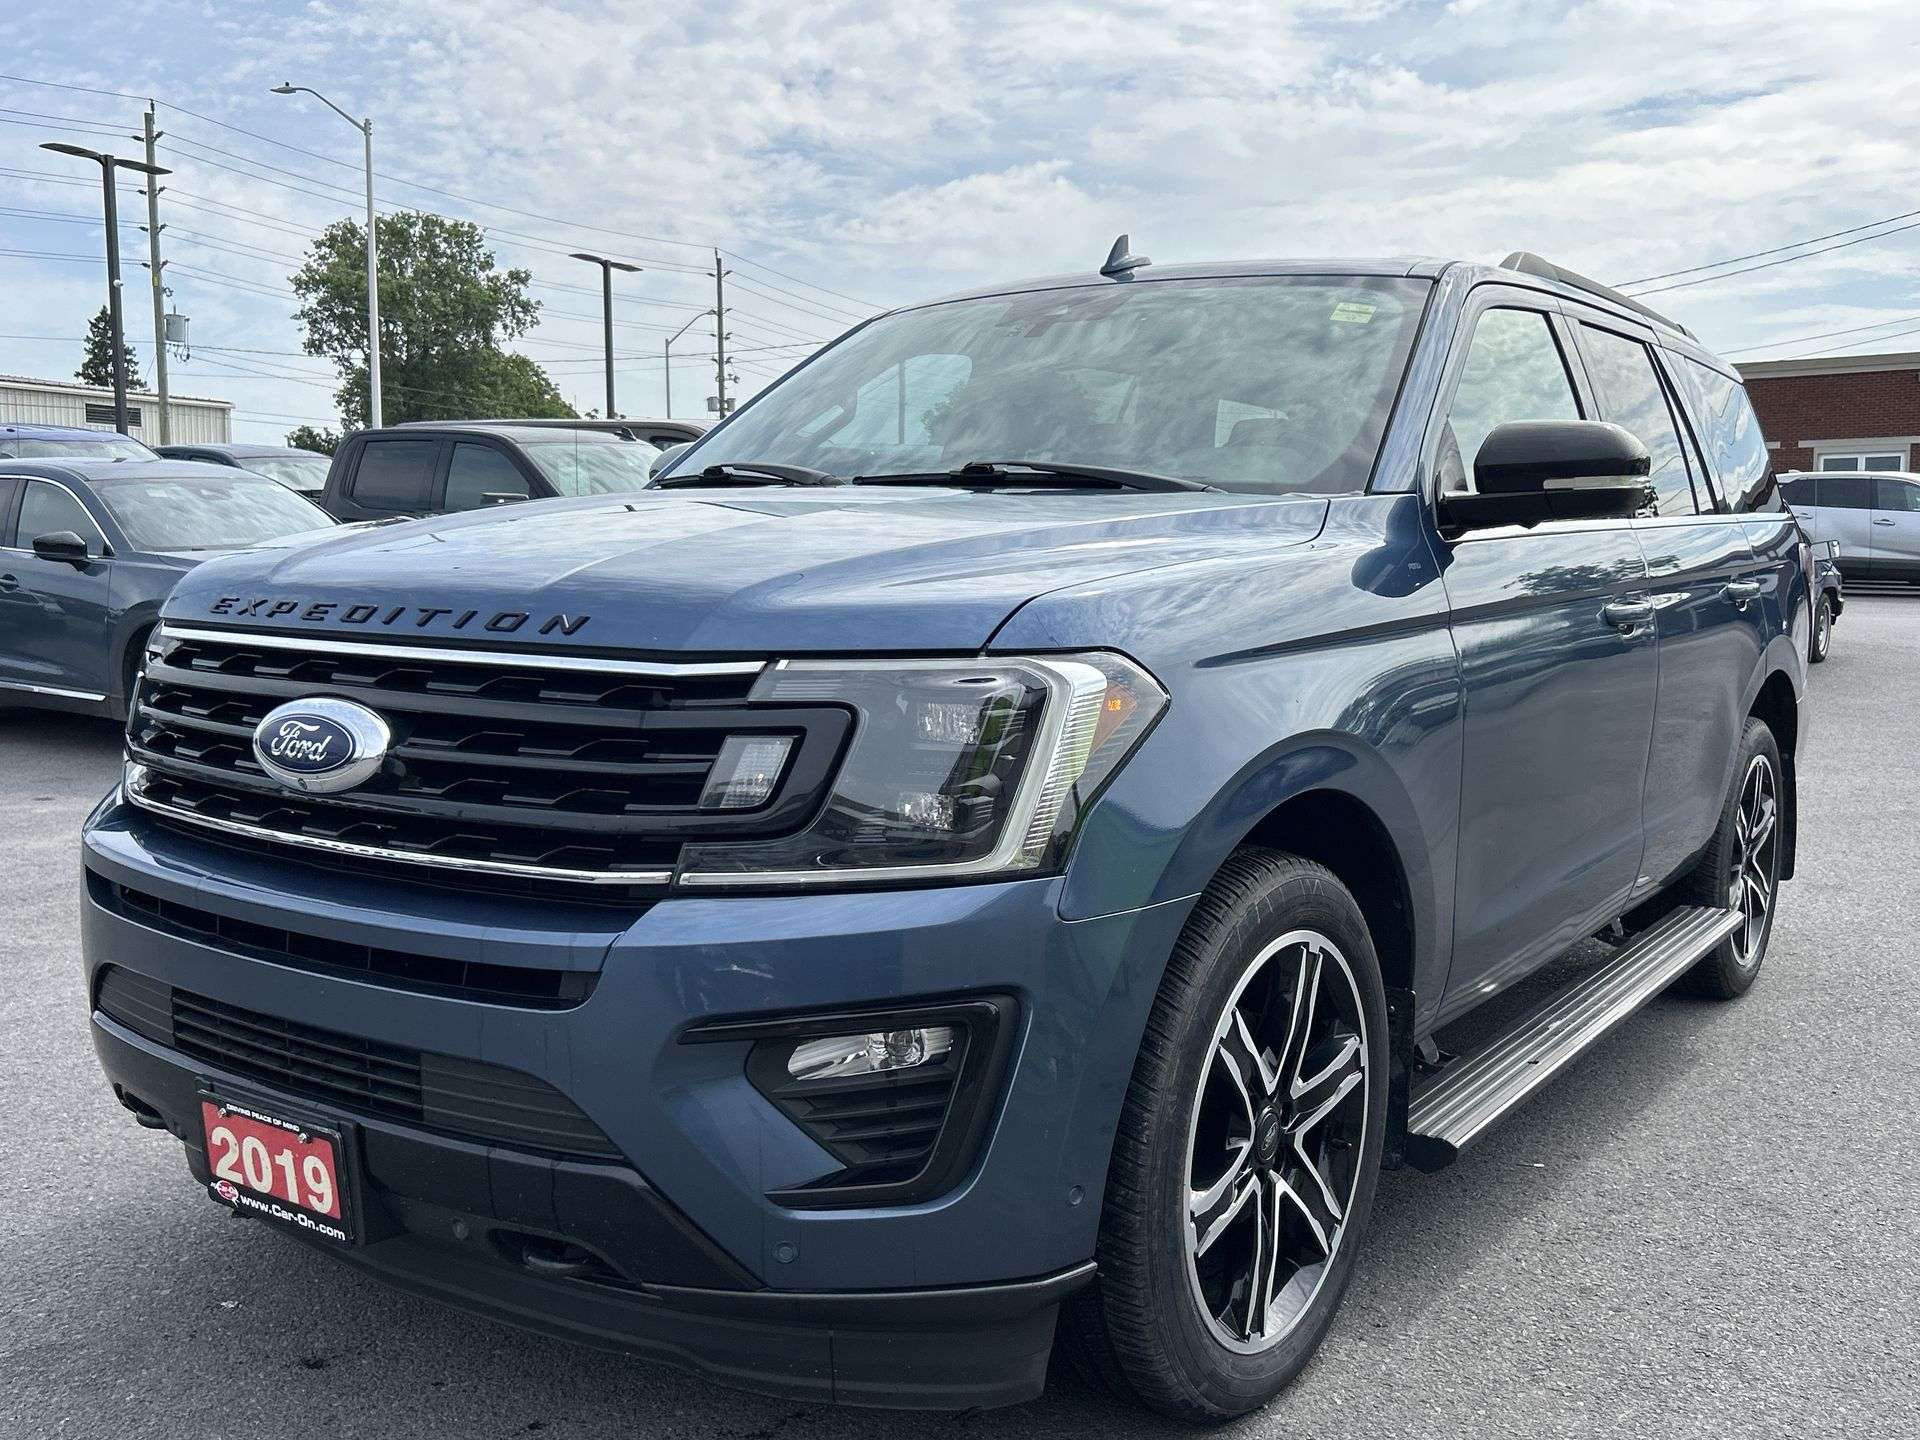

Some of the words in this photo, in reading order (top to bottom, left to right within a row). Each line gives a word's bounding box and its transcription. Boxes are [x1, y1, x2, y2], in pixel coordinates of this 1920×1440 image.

[209, 597, 591, 636] EXPEDITION
[271, 720, 333, 762] Ford
[211, 1126, 333, 1214] 2019
[240, 1194, 346, 1241] www.Car-On.com
